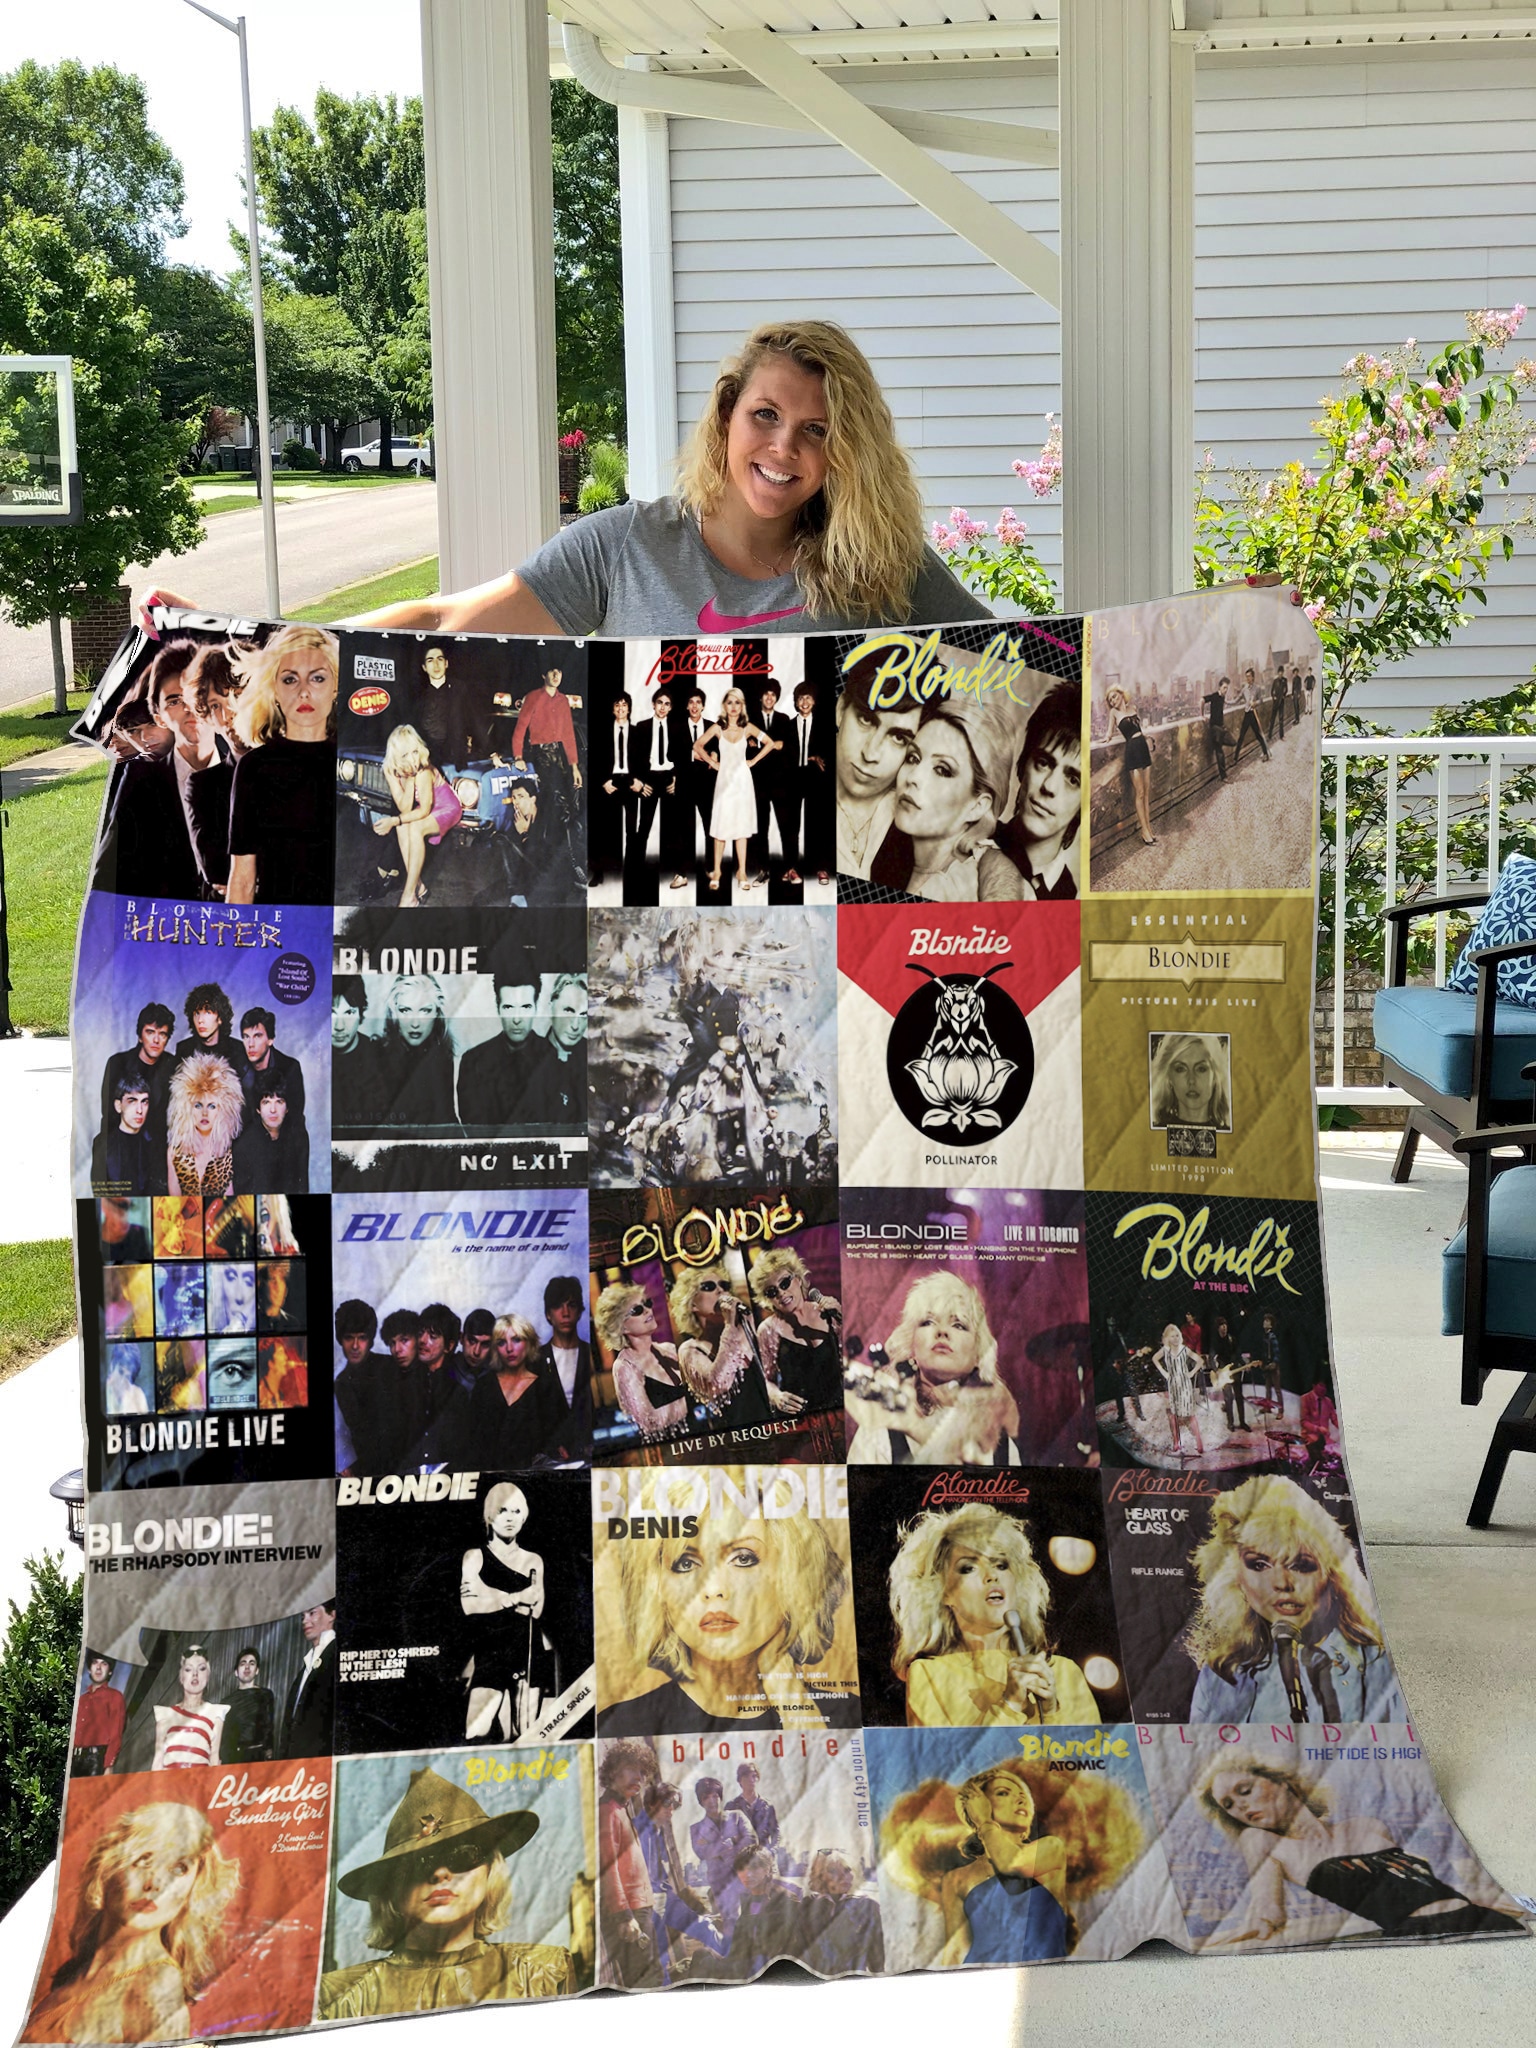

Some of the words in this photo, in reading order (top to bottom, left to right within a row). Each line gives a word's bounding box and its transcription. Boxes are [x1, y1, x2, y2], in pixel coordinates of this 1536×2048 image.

[12, 489, 61, 502] SPALDING
[1098, 590, 1283, 640] BLONDI
[356, 668, 394, 679] LETTERS
[357, 660, 393, 671] PLASTIC
[645, 643, 774, 687] Blondie
[841, 628, 1031, 711] Blondie
[352, 692, 388, 710] DENIS
[126, 900, 283, 923] BLONDIE
[1131, 914, 1248, 926] ESSENTIAL
[131, 914, 284, 949] HUNTER
[908, 925, 1012, 956] Blondie
[338, 946, 478, 975] BLONDIE
[1121, 997, 1178, 1006] PICTURE
[1188, 998, 1218, 1006] THIS
[1227, 999, 1257, 1007] LIVE
[460, 1154, 498, 1171] NO
[512, 1154, 573, 1171] EXIT
[925, 1155, 998, 1165] POLLINATOR
[1150, 1163, 1189, 1173] LIMITED
[1194, 1165, 1234, 1175] EDITION
[1182, 1174, 1205, 1183] 1998
[337, 1208, 577, 1243] BLONDIE
[620, 1193, 804, 1267] BLONDIE
[846, 1223, 968, 1241] BLONDIE
[1003, 1225, 1023, 1241] LIVE
[1026, 1226, 1036, 1242] IN
[1039, 1227, 1080, 1243] TORONTO
[451, 1244, 463, 1254] is
[465, 1243, 483, 1253] the
[485, 1244, 516, 1253] name
[517, 1243, 532, 1252] of
[532, 1244, 540, 1252] a
[541, 1242, 570, 1252] band
[1113, 1202, 1303, 1297] Blondie
[1193, 1281, 1206, 1291] AT
[1208, 1281, 1228, 1292] THE
[1230, 1283, 1250, 1294] BBC
[106, 1416, 219, 1454] BLONDIE
[227, 1413, 285, 1448] LIVE
[670, 1436, 704, 1456] LIVE
[708, 1434, 726, 1448] BY
[732, 1418, 799, 1443] REQUEST
[337, 1472, 480, 1506] BLONDIE
[591, 1466, 850, 1523] BLONDIE
[921, 1470, 1030, 1507] Blondie
[1109, 1469, 1221, 1504] Blondie
[1124, 1507, 1169, 1521] HEART
[1170, 1508, 1190, 1522] OF
[88, 1513, 273, 1557] BLONDIE:
[608, 1515, 699, 1540] DENIS
[1126, 1520, 1173, 1536] GLASS
[122, 1551, 220, 1572] RHAPSODY
[224, 1545, 323, 1565] INTERVIEW
[1131, 1567, 1154, 1576] RIFLE
[1155, 1567, 1185, 1577] RANGE
[339, 1651, 359, 1661] RIP
[360, 1650, 381, 1660] HER
[381, 1648, 397, 1659] TO
[398, 1645, 440, 1658] SHREDS
[339, 1661, 352, 1672] IN
[353, 1660, 374, 1671] THE
[375, 1658, 407, 1669] FLESH
[339, 1671, 348, 1682] X
[349, 1668, 405, 1682] OFFENDER
[539, 1730, 547, 1739] 3
[544, 1709, 568, 1733] TRACK
[566, 1686, 592, 1712] SINGLE
[737, 1705, 780, 1713] PLATINUM
[673, 1734, 839, 1763] blondie
[851, 1739, 865, 1772] union
[1018, 1728, 1130, 1762] Blondie
[1305, 1747, 1334, 1761] THE
[1336, 1747, 1370, 1760] TIDE
[1373, 1747, 1388, 1760] IS
[464, 1748, 570, 1788] Blondie
[1048, 1758, 1106, 1772] ATOMIC
[208, 1767, 329, 1810] Blondie
[473, 1780, 565, 1795] DREAMING
[853, 1775, 868, 1798] city
[224, 1805, 291, 1828] Sunday
[292, 1800, 327, 1826] Girl
[857, 1802, 871, 1828] blue
